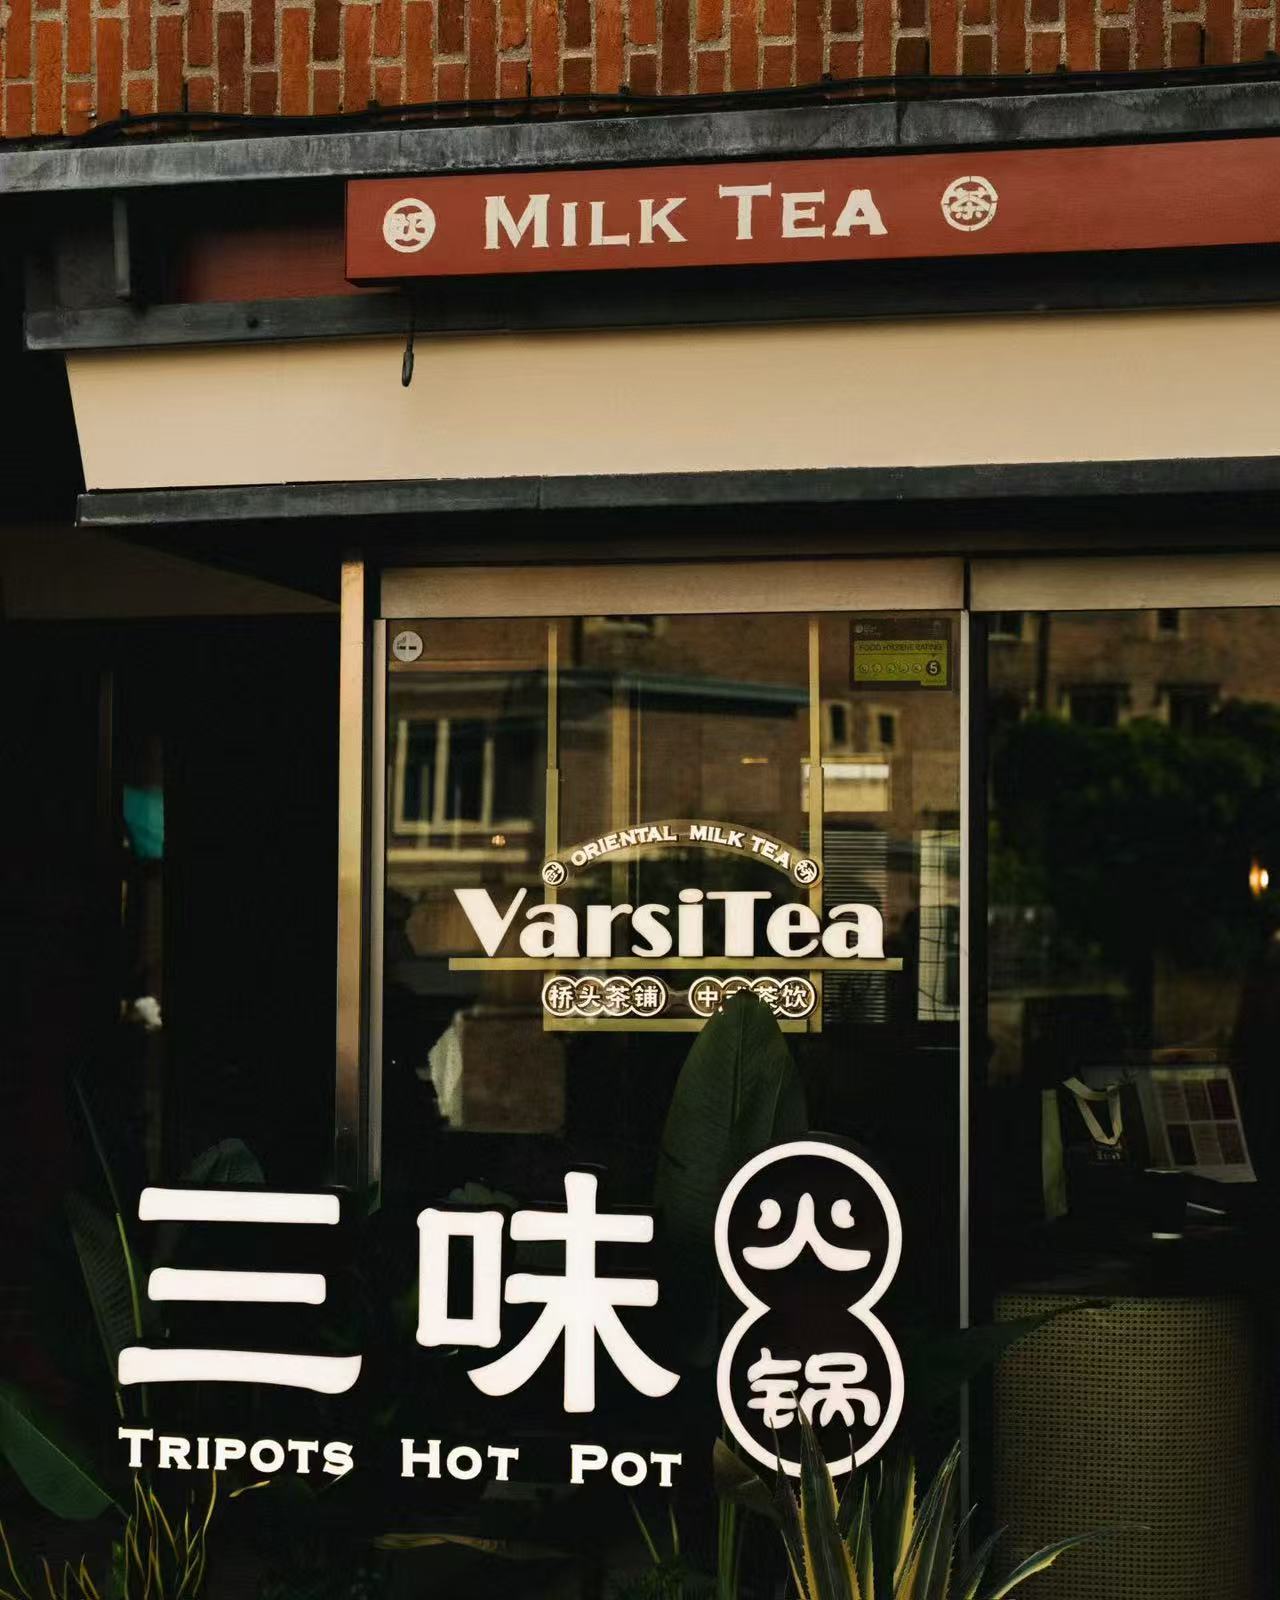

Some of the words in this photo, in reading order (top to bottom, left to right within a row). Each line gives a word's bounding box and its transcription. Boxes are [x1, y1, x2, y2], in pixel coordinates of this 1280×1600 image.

[485, 194, 687, 250] MILK
[719, 182, 887, 240] TEA
[571, 825, 678, 866] ORIENTAL
[690, 825, 745, 848] MILK
[751, 835, 792, 869] TEA
[453, 887, 885, 959] VarsiTea
[549, 985, 659, 1009] 桥头茶铺
[119, 1427, 354, 1475] TRIPOTS
[401, 1439, 519, 1481] HOT
[570, 1444, 682, 1488] POT
